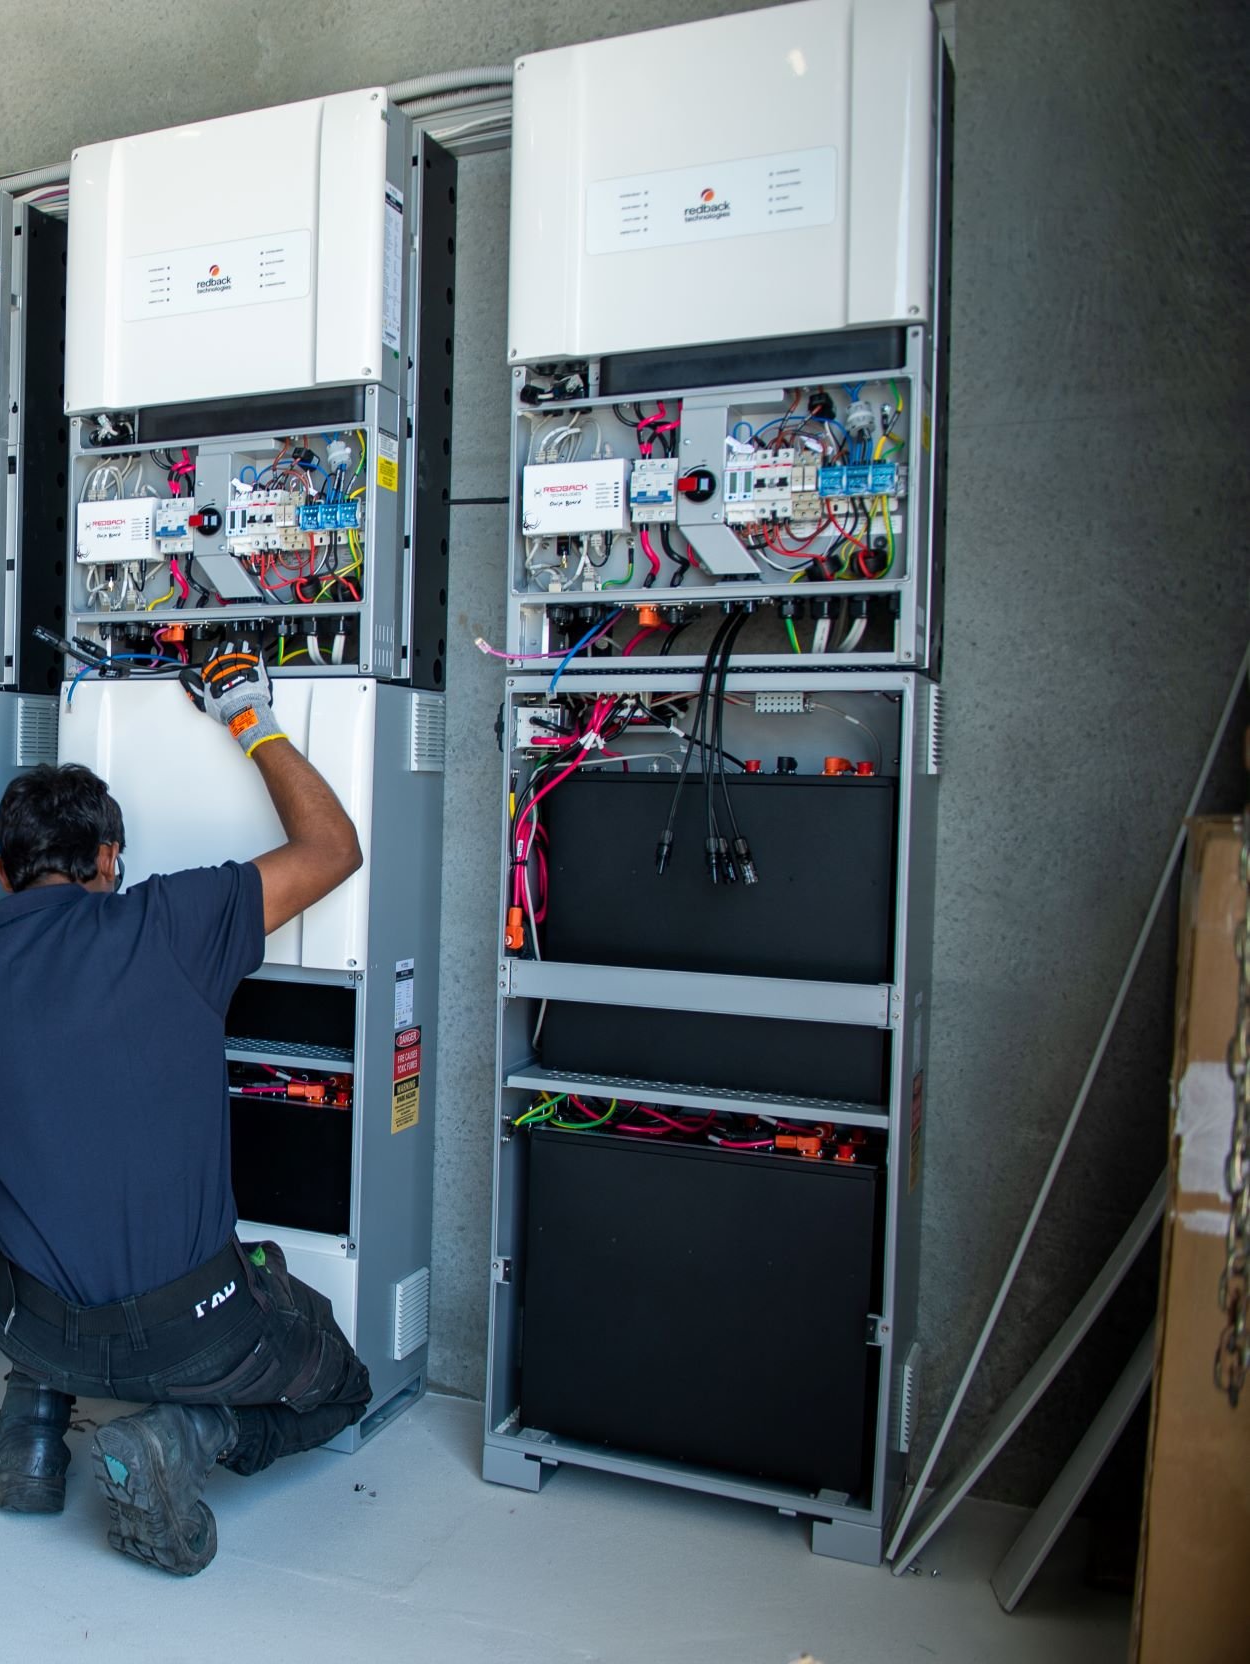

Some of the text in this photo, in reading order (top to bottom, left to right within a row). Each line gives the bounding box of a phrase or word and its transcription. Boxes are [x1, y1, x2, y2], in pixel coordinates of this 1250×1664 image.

[685, 200, 731, 216] redback
[685, 211, 731, 223] technologies
[196, 276, 232, 288] redback
[196, 284, 232, 295] technologies
[543, 484, 588, 493] REDBACK
[92, 519, 126, 527] REDBACK
[399, 1031, 417, 1045] DANGER
[397, 1054, 405, 1064] FIRE
